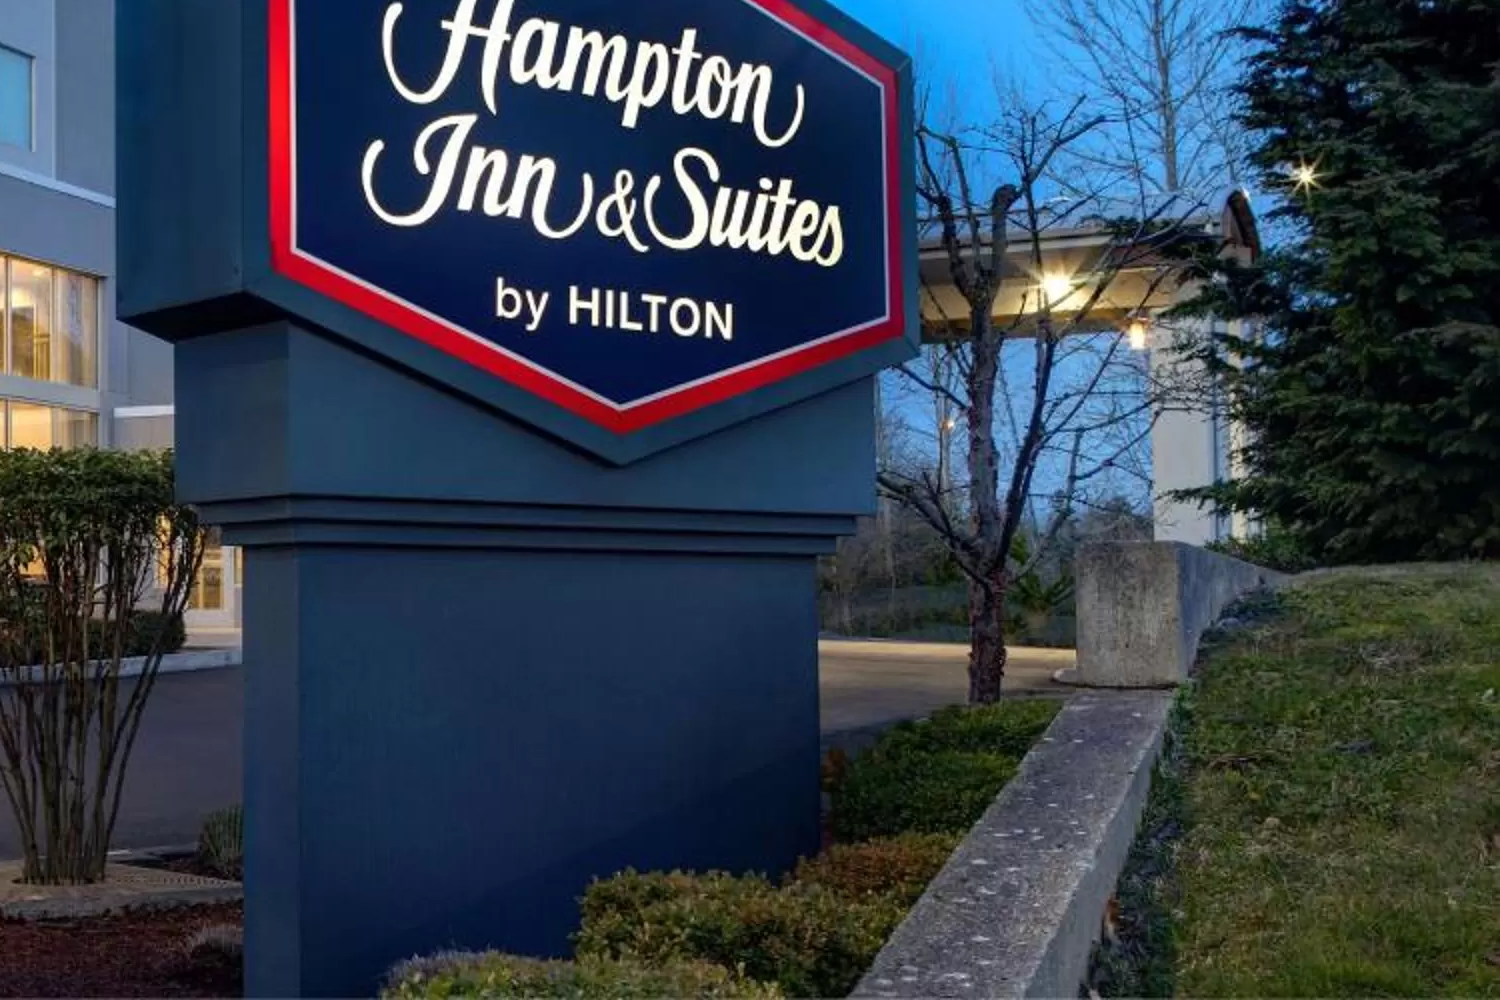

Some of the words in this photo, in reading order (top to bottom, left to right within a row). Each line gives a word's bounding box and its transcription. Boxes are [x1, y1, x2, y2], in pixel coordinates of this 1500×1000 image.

[361, 112, 595, 240] Inn
[595, 168, 650, 254] &
[643, 146, 845, 268] Suites
[494, 276, 551, 332] by
[567, 285, 734, 341] HILTON
